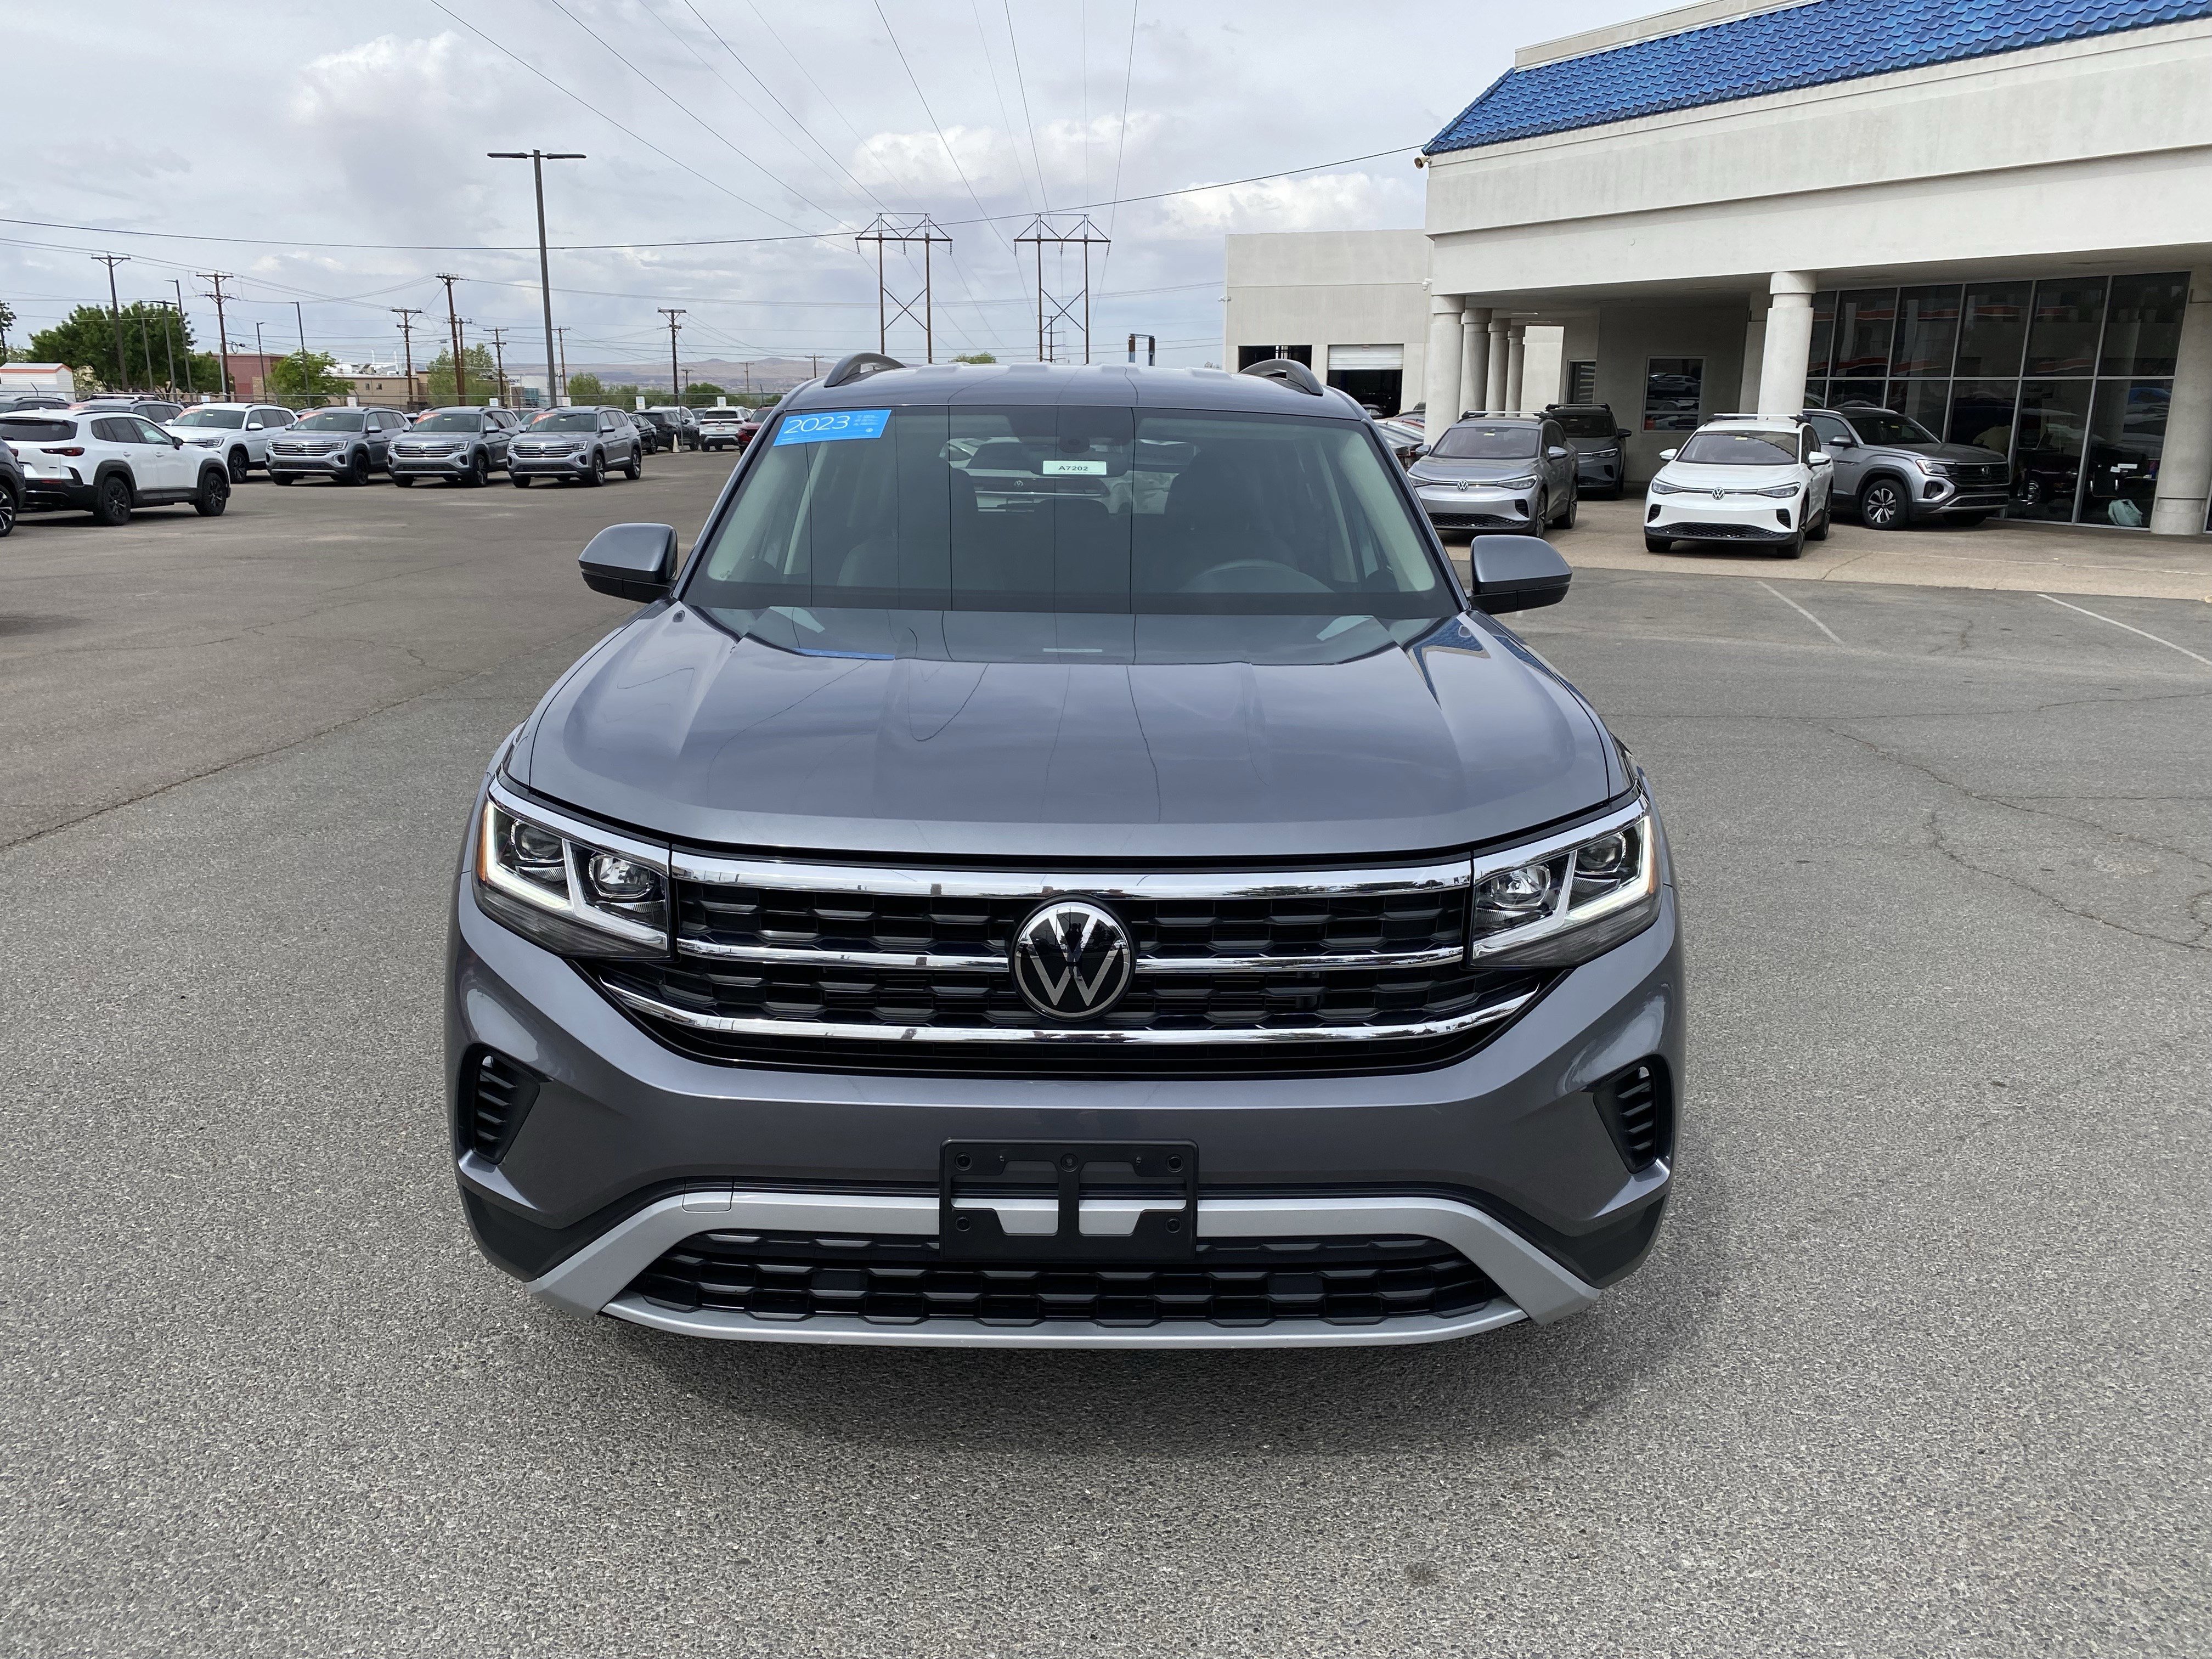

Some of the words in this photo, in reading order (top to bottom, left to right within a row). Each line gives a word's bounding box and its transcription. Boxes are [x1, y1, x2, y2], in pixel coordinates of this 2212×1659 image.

[784, 415, 850, 434] 2023
[1458, 480, 1469, 491] VW
[1712, 488, 1724, 499] VW
[1017, 904, 1129, 1015] VW
